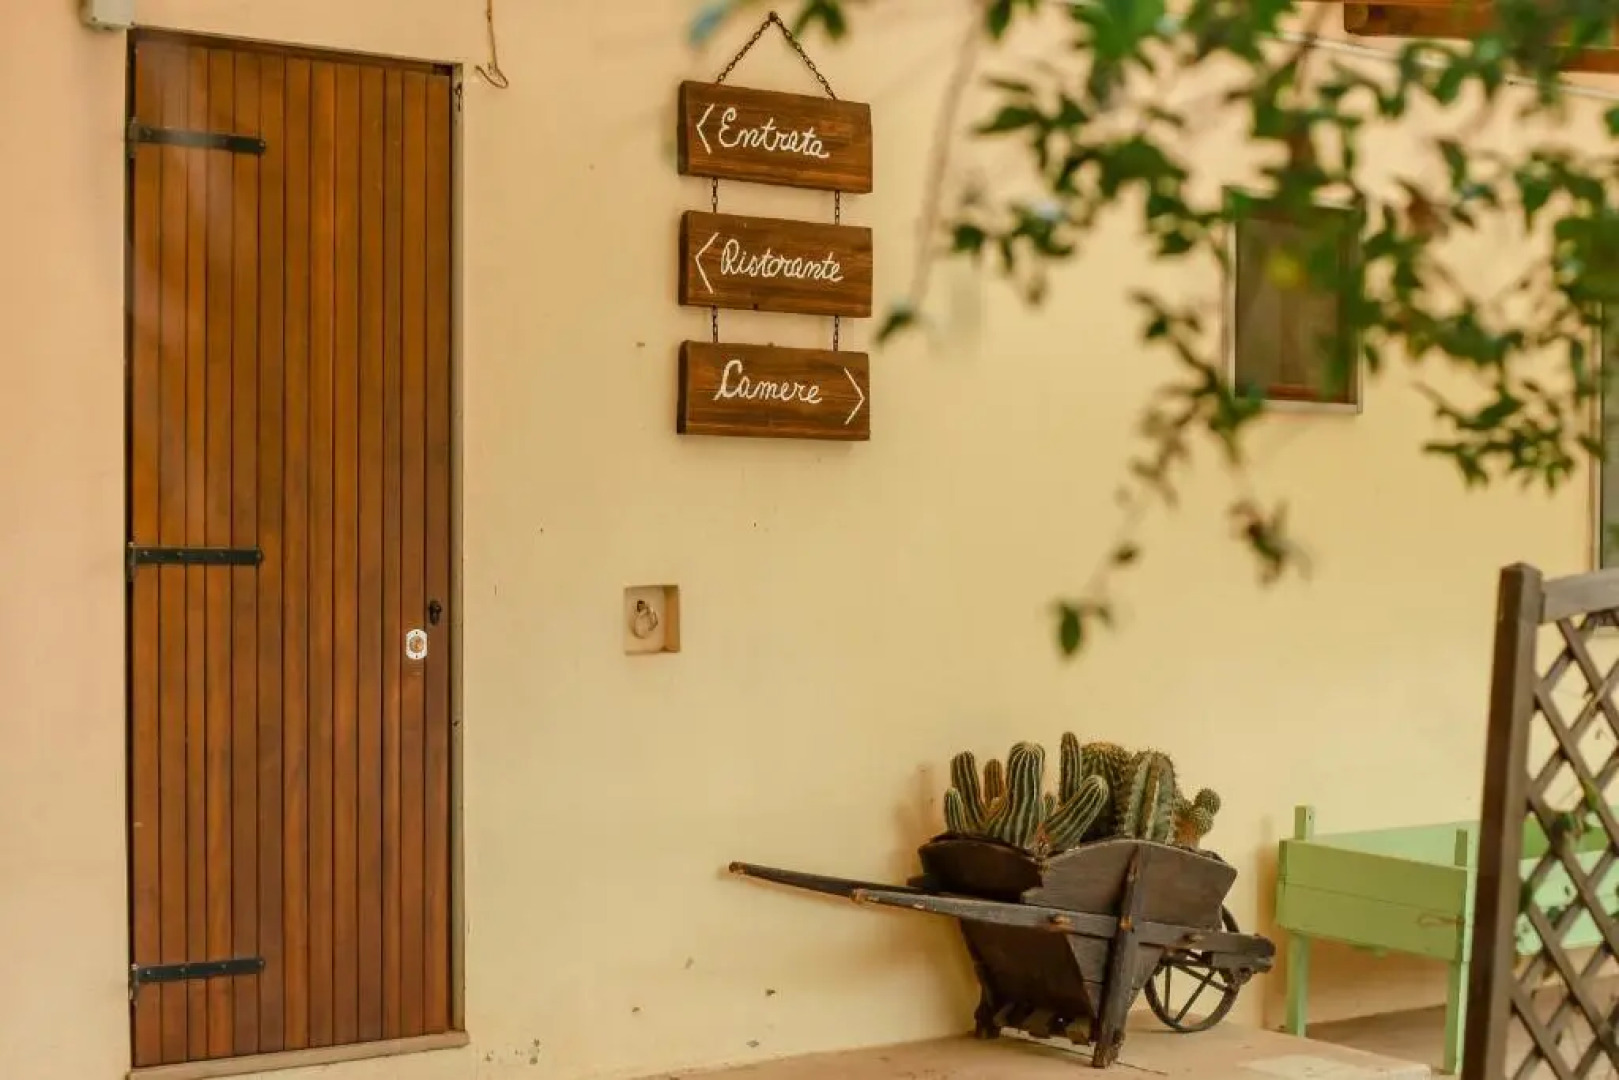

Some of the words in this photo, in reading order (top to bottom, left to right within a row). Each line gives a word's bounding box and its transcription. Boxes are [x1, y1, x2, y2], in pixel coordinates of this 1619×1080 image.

[718, 107, 830, 160] Entrata
[720, 238, 844, 282] Ristorante
[714, 359, 823, 405] Camere
